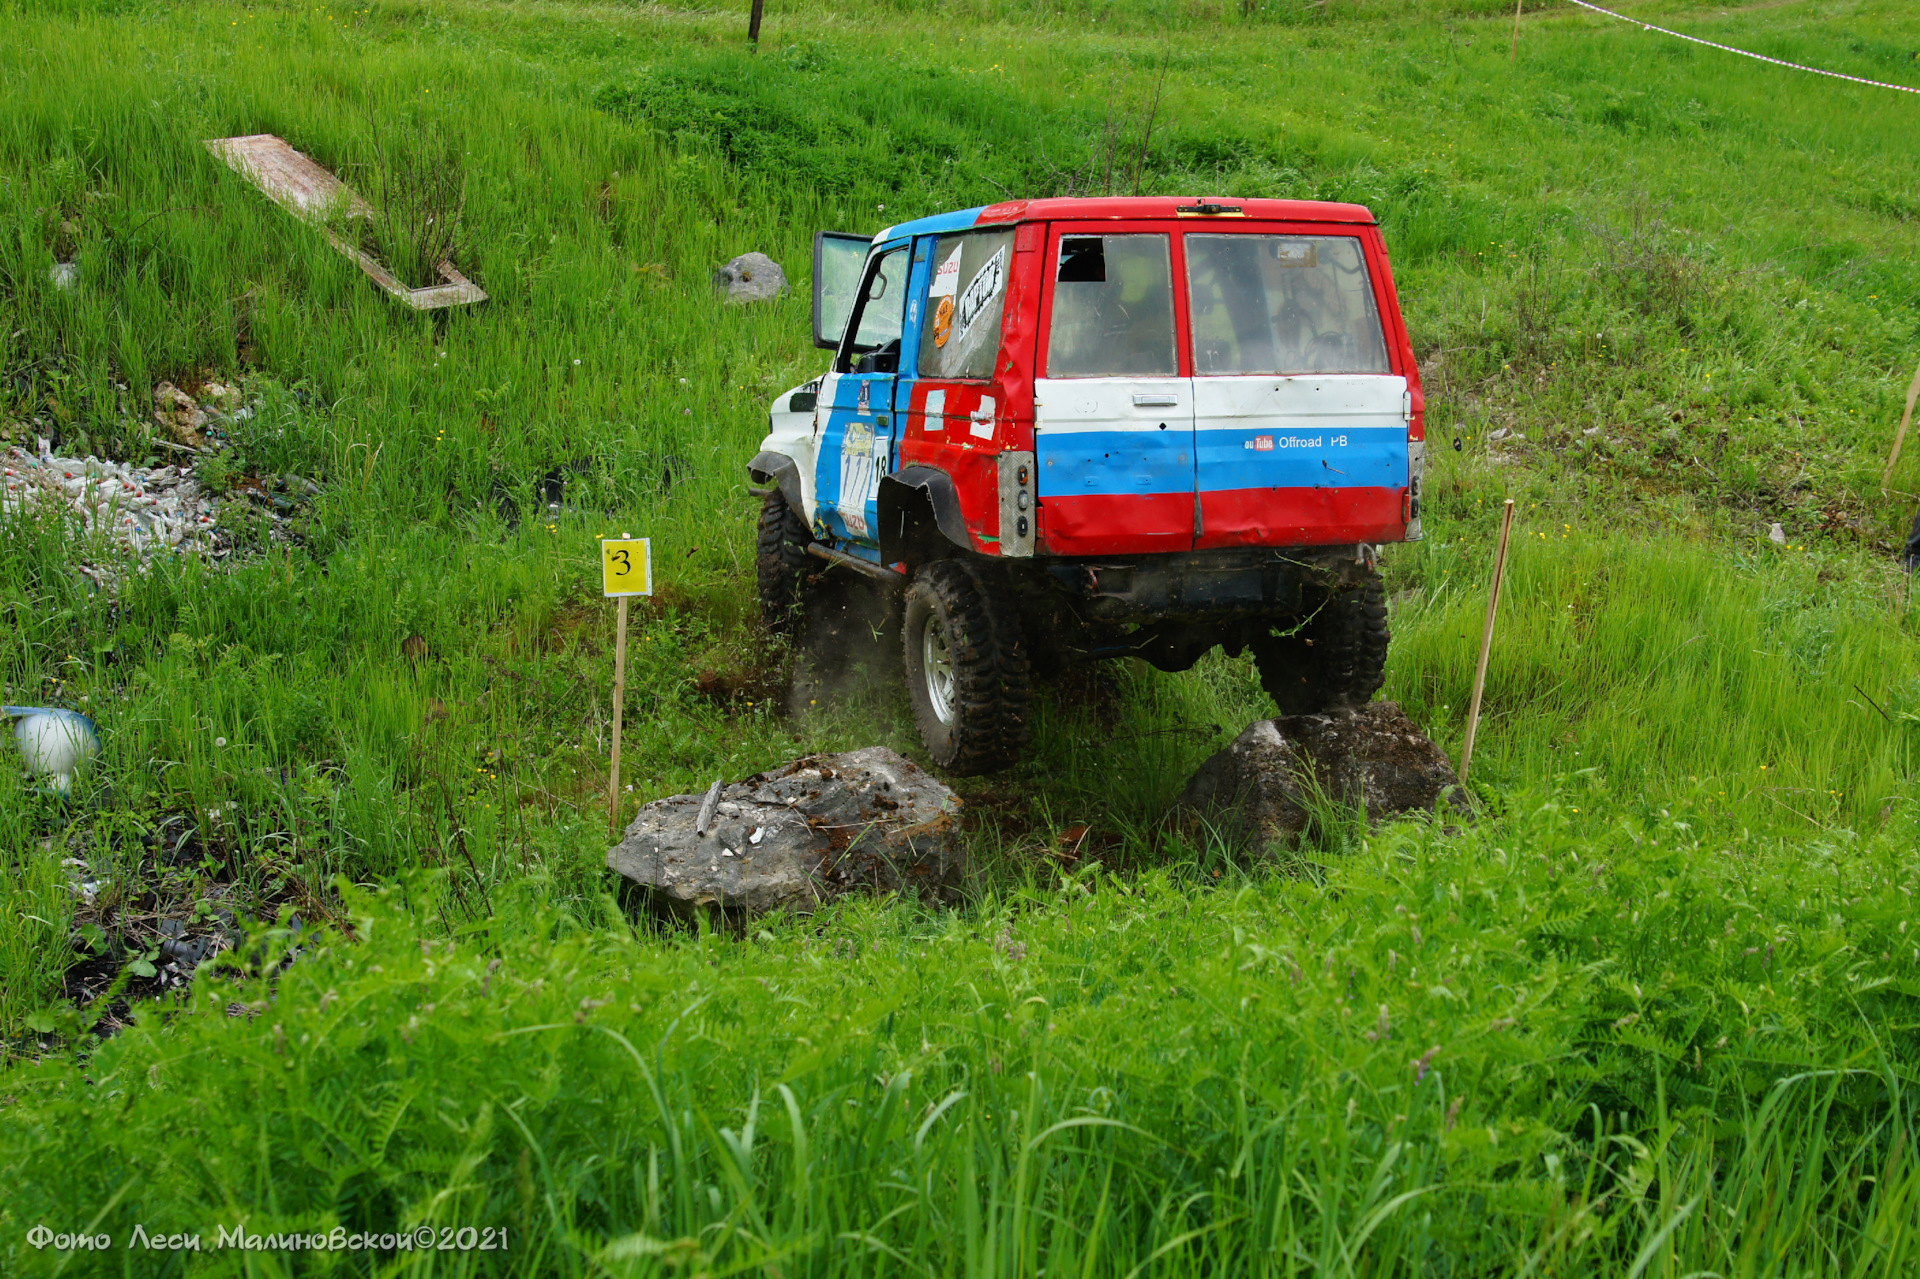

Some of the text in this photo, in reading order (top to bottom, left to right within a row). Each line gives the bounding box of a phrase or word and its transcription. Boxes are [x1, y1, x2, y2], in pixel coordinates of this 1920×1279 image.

[1279, 436, 1322, 448] Offroad
[875, 455, 887, 483] 18
[615, 549, 631, 576] 3
